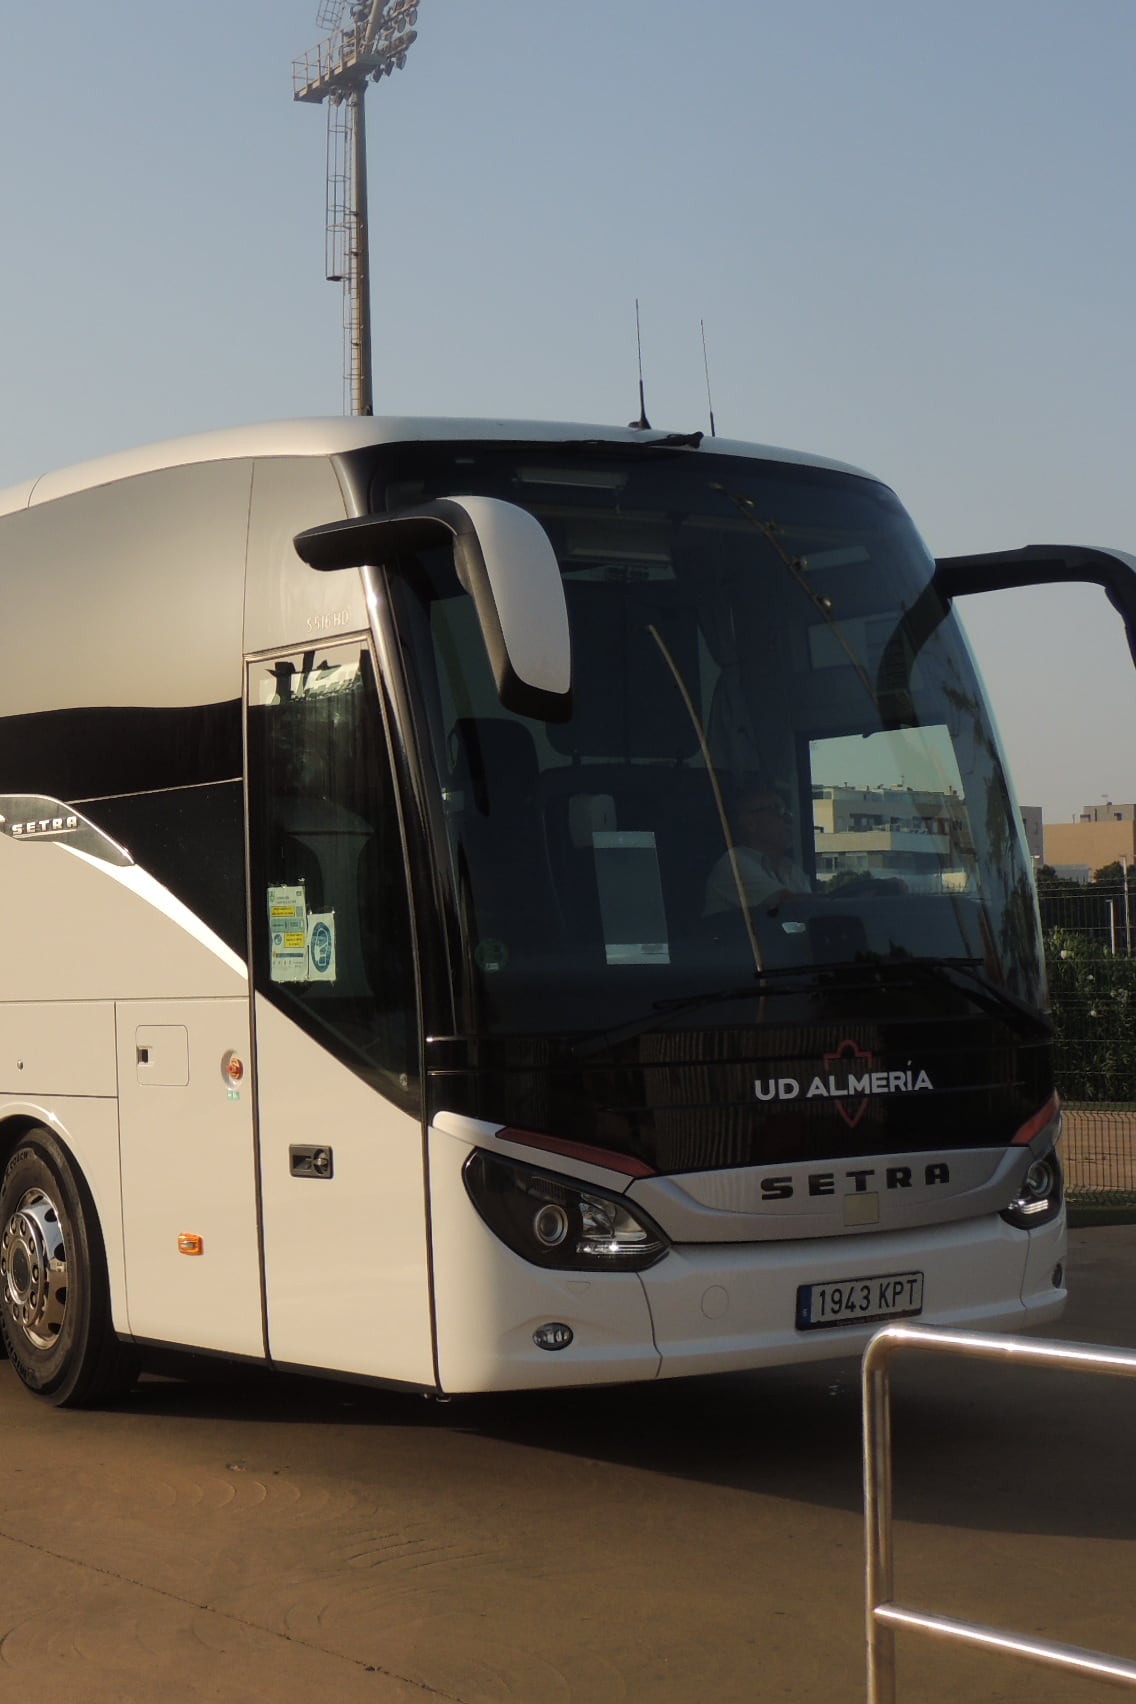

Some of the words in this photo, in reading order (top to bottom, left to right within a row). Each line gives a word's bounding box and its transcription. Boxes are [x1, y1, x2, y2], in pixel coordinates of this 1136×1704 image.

[12, 815, 77, 835] SETRA
[754, 1078, 799, 1101] UD
[806, 1060, 933, 1099] ALMERÍA
[760, 1162, 950, 1200] SETRA
[819, 1283, 872, 1316] 1943
[878, 1278, 918, 1310] KPT
